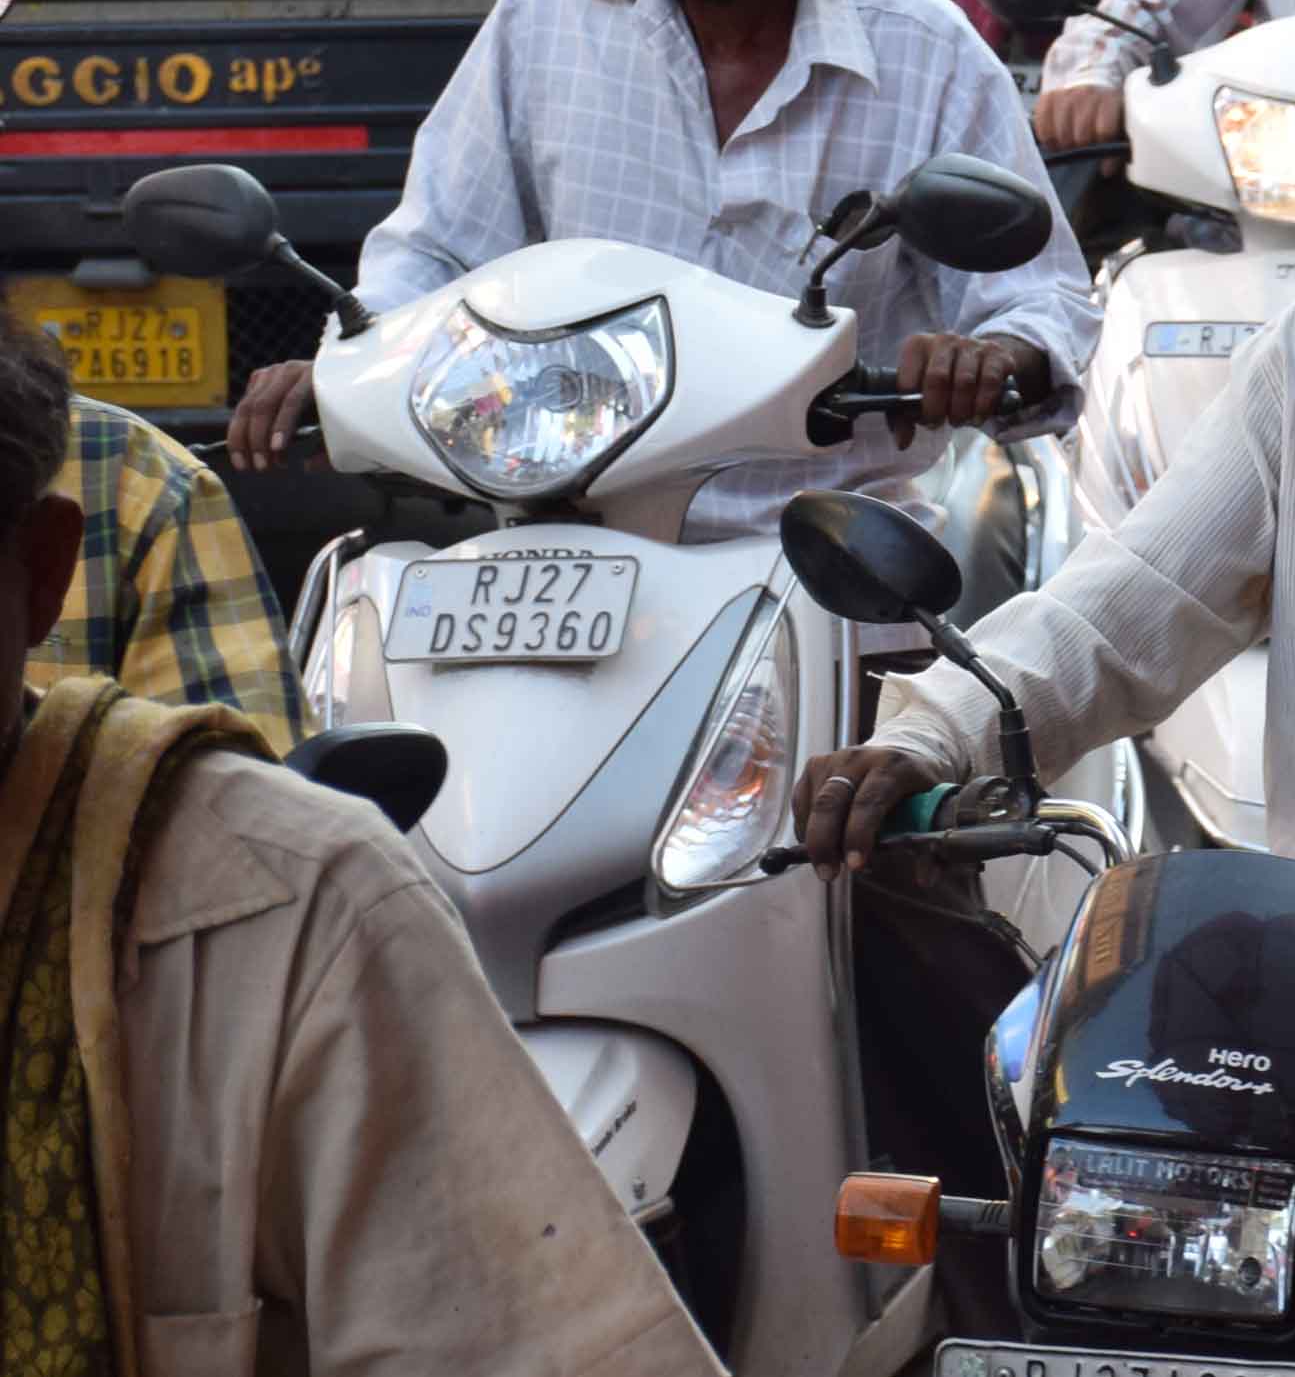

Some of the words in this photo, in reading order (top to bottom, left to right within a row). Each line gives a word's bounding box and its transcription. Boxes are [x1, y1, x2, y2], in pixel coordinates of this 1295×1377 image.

[0, 53, 213, 106] GGIO
[83, 310, 169, 342] RJ27
[471, 562, 593, 607] RJ27
[430, 610, 613, 654] DS9360
[1208, 1047, 1272, 1072] Hero
